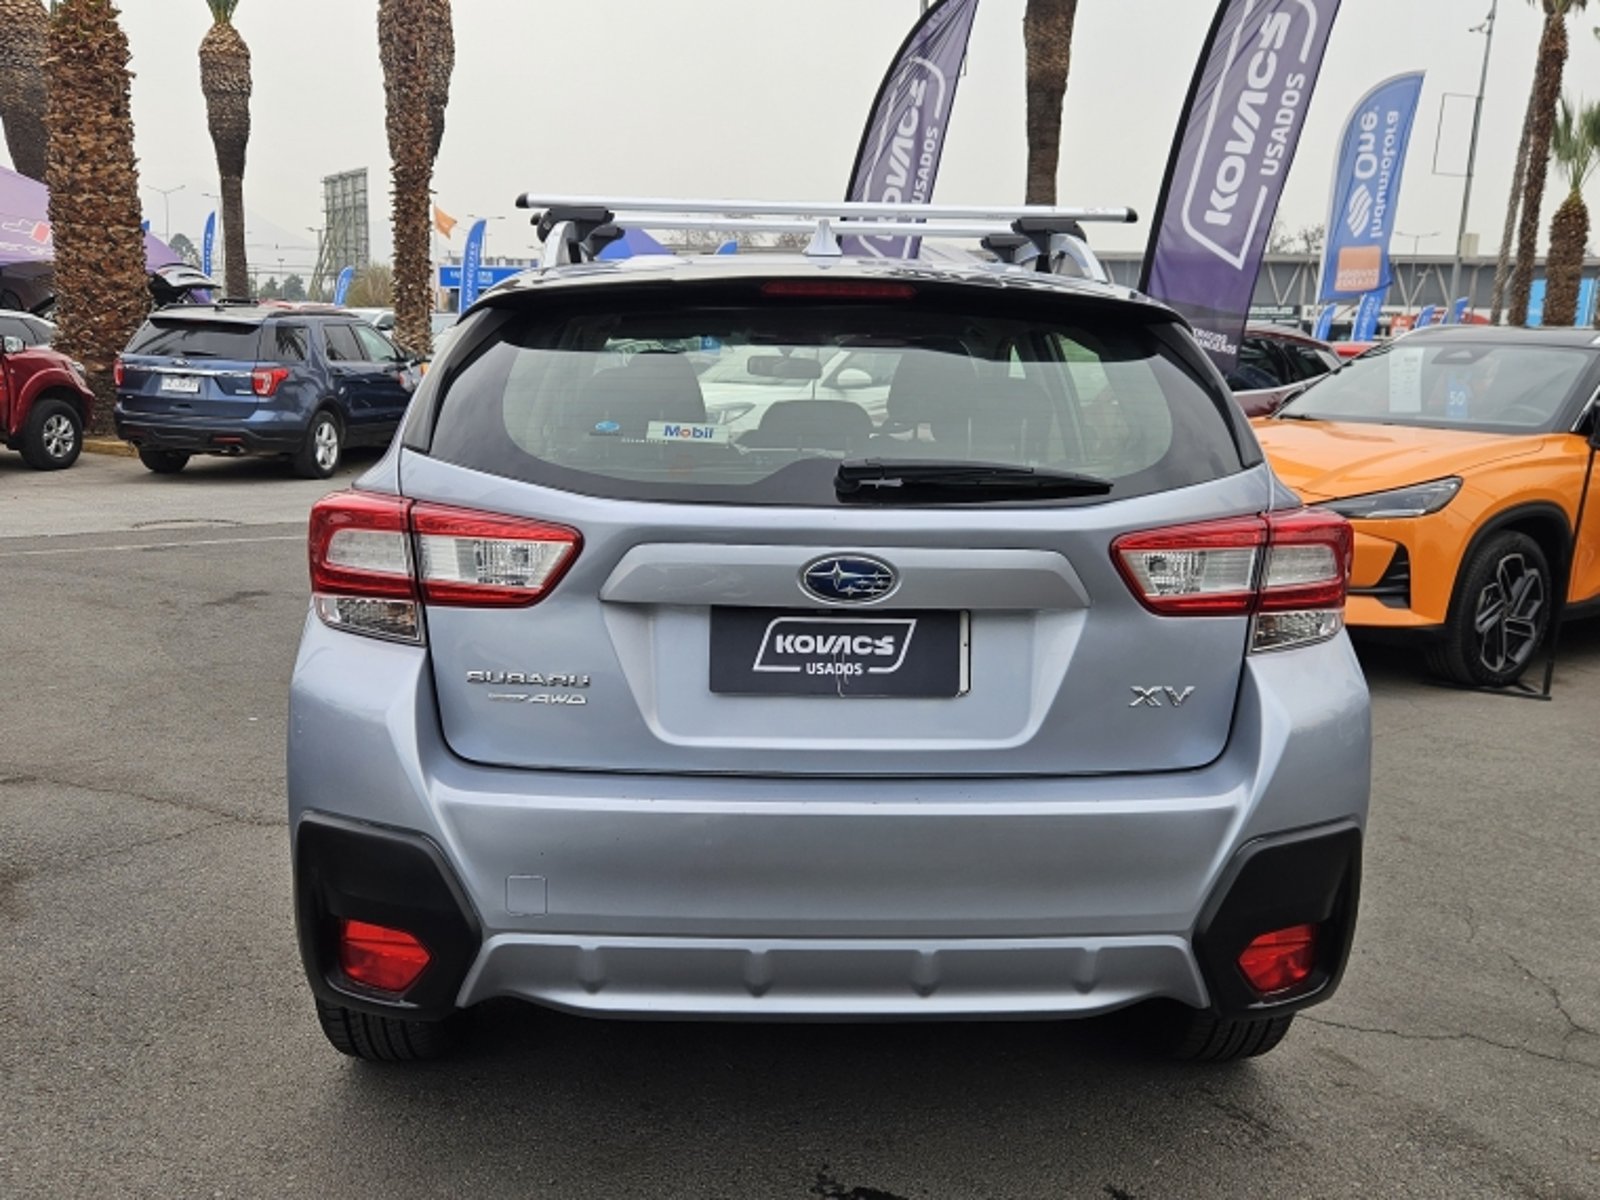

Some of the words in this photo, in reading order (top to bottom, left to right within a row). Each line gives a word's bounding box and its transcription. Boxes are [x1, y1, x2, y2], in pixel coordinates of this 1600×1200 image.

[1204, 12, 1291, 226] KOVACS
[1260, 73, 1306, 176] USADOS
[911, 126, 938, 204] USADOS
[664, 425, 714, 439] Mobil
[776, 634, 895, 655] KOVACS
[466, 670, 590, 688] SUBARU
[806, 662, 863, 676] USADOS
[528, 693, 588, 705] AWD
[1128, 685, 1196, 707] XV
